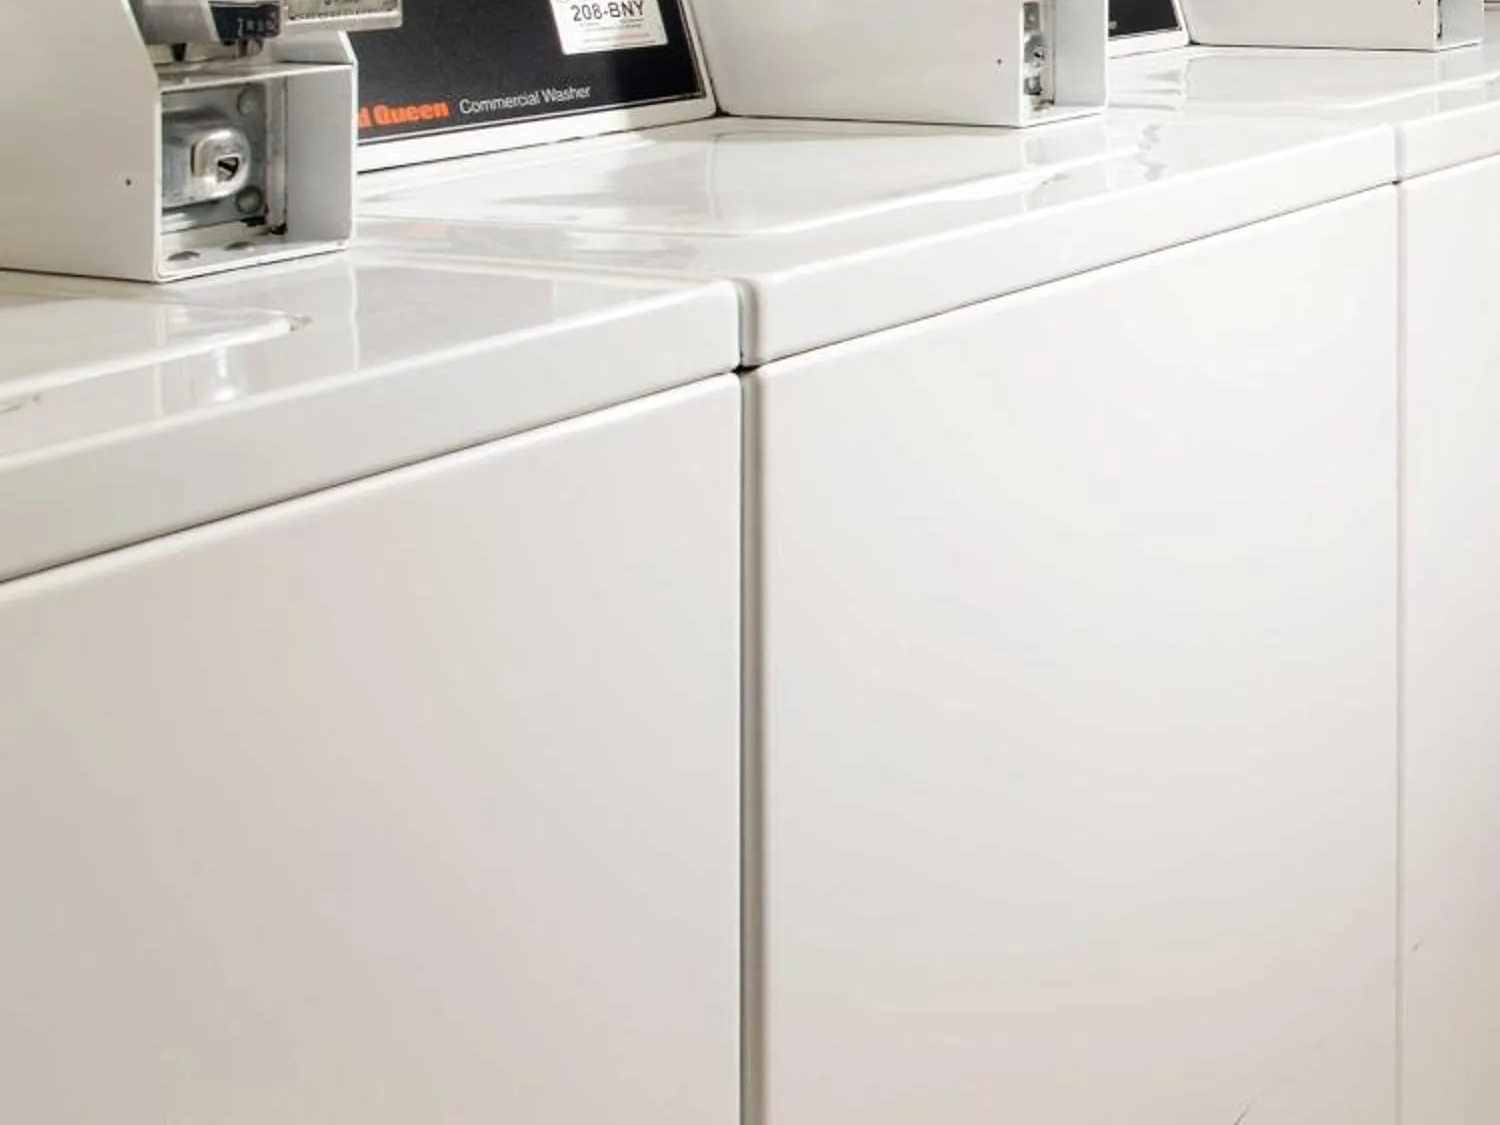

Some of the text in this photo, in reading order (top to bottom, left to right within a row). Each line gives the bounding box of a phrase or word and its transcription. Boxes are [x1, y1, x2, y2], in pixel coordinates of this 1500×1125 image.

[570, 0, 645, 22] 208-BNY
[373, 101, 449, 125] Queen
[459, 88, 540, 115] Commercial
[541, 85, 591, 104] Washer
